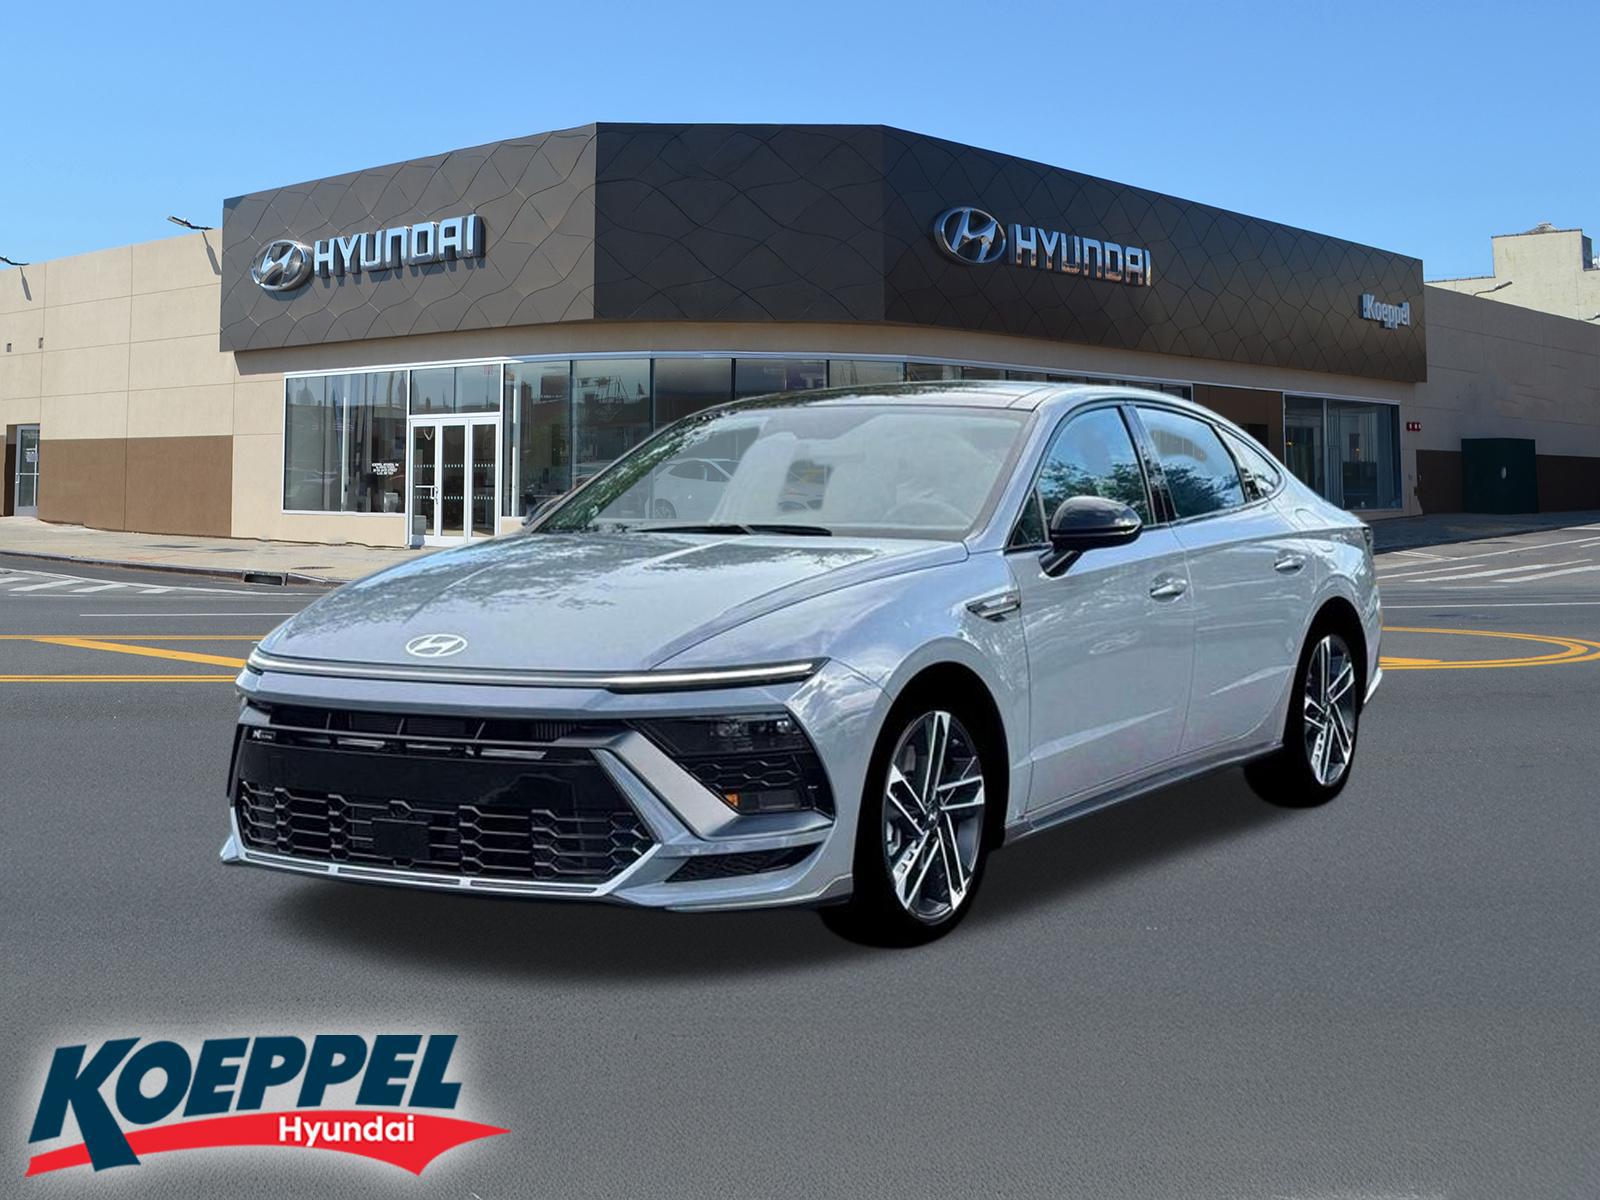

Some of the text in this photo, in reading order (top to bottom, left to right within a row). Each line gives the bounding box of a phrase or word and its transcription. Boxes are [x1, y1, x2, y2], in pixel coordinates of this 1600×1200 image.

[314, 213, 482, 278] HYUNDAI
[1013, 223, 1152, 287] HYUNDAI
[1362, 293, 1410, 329] Koeppel
